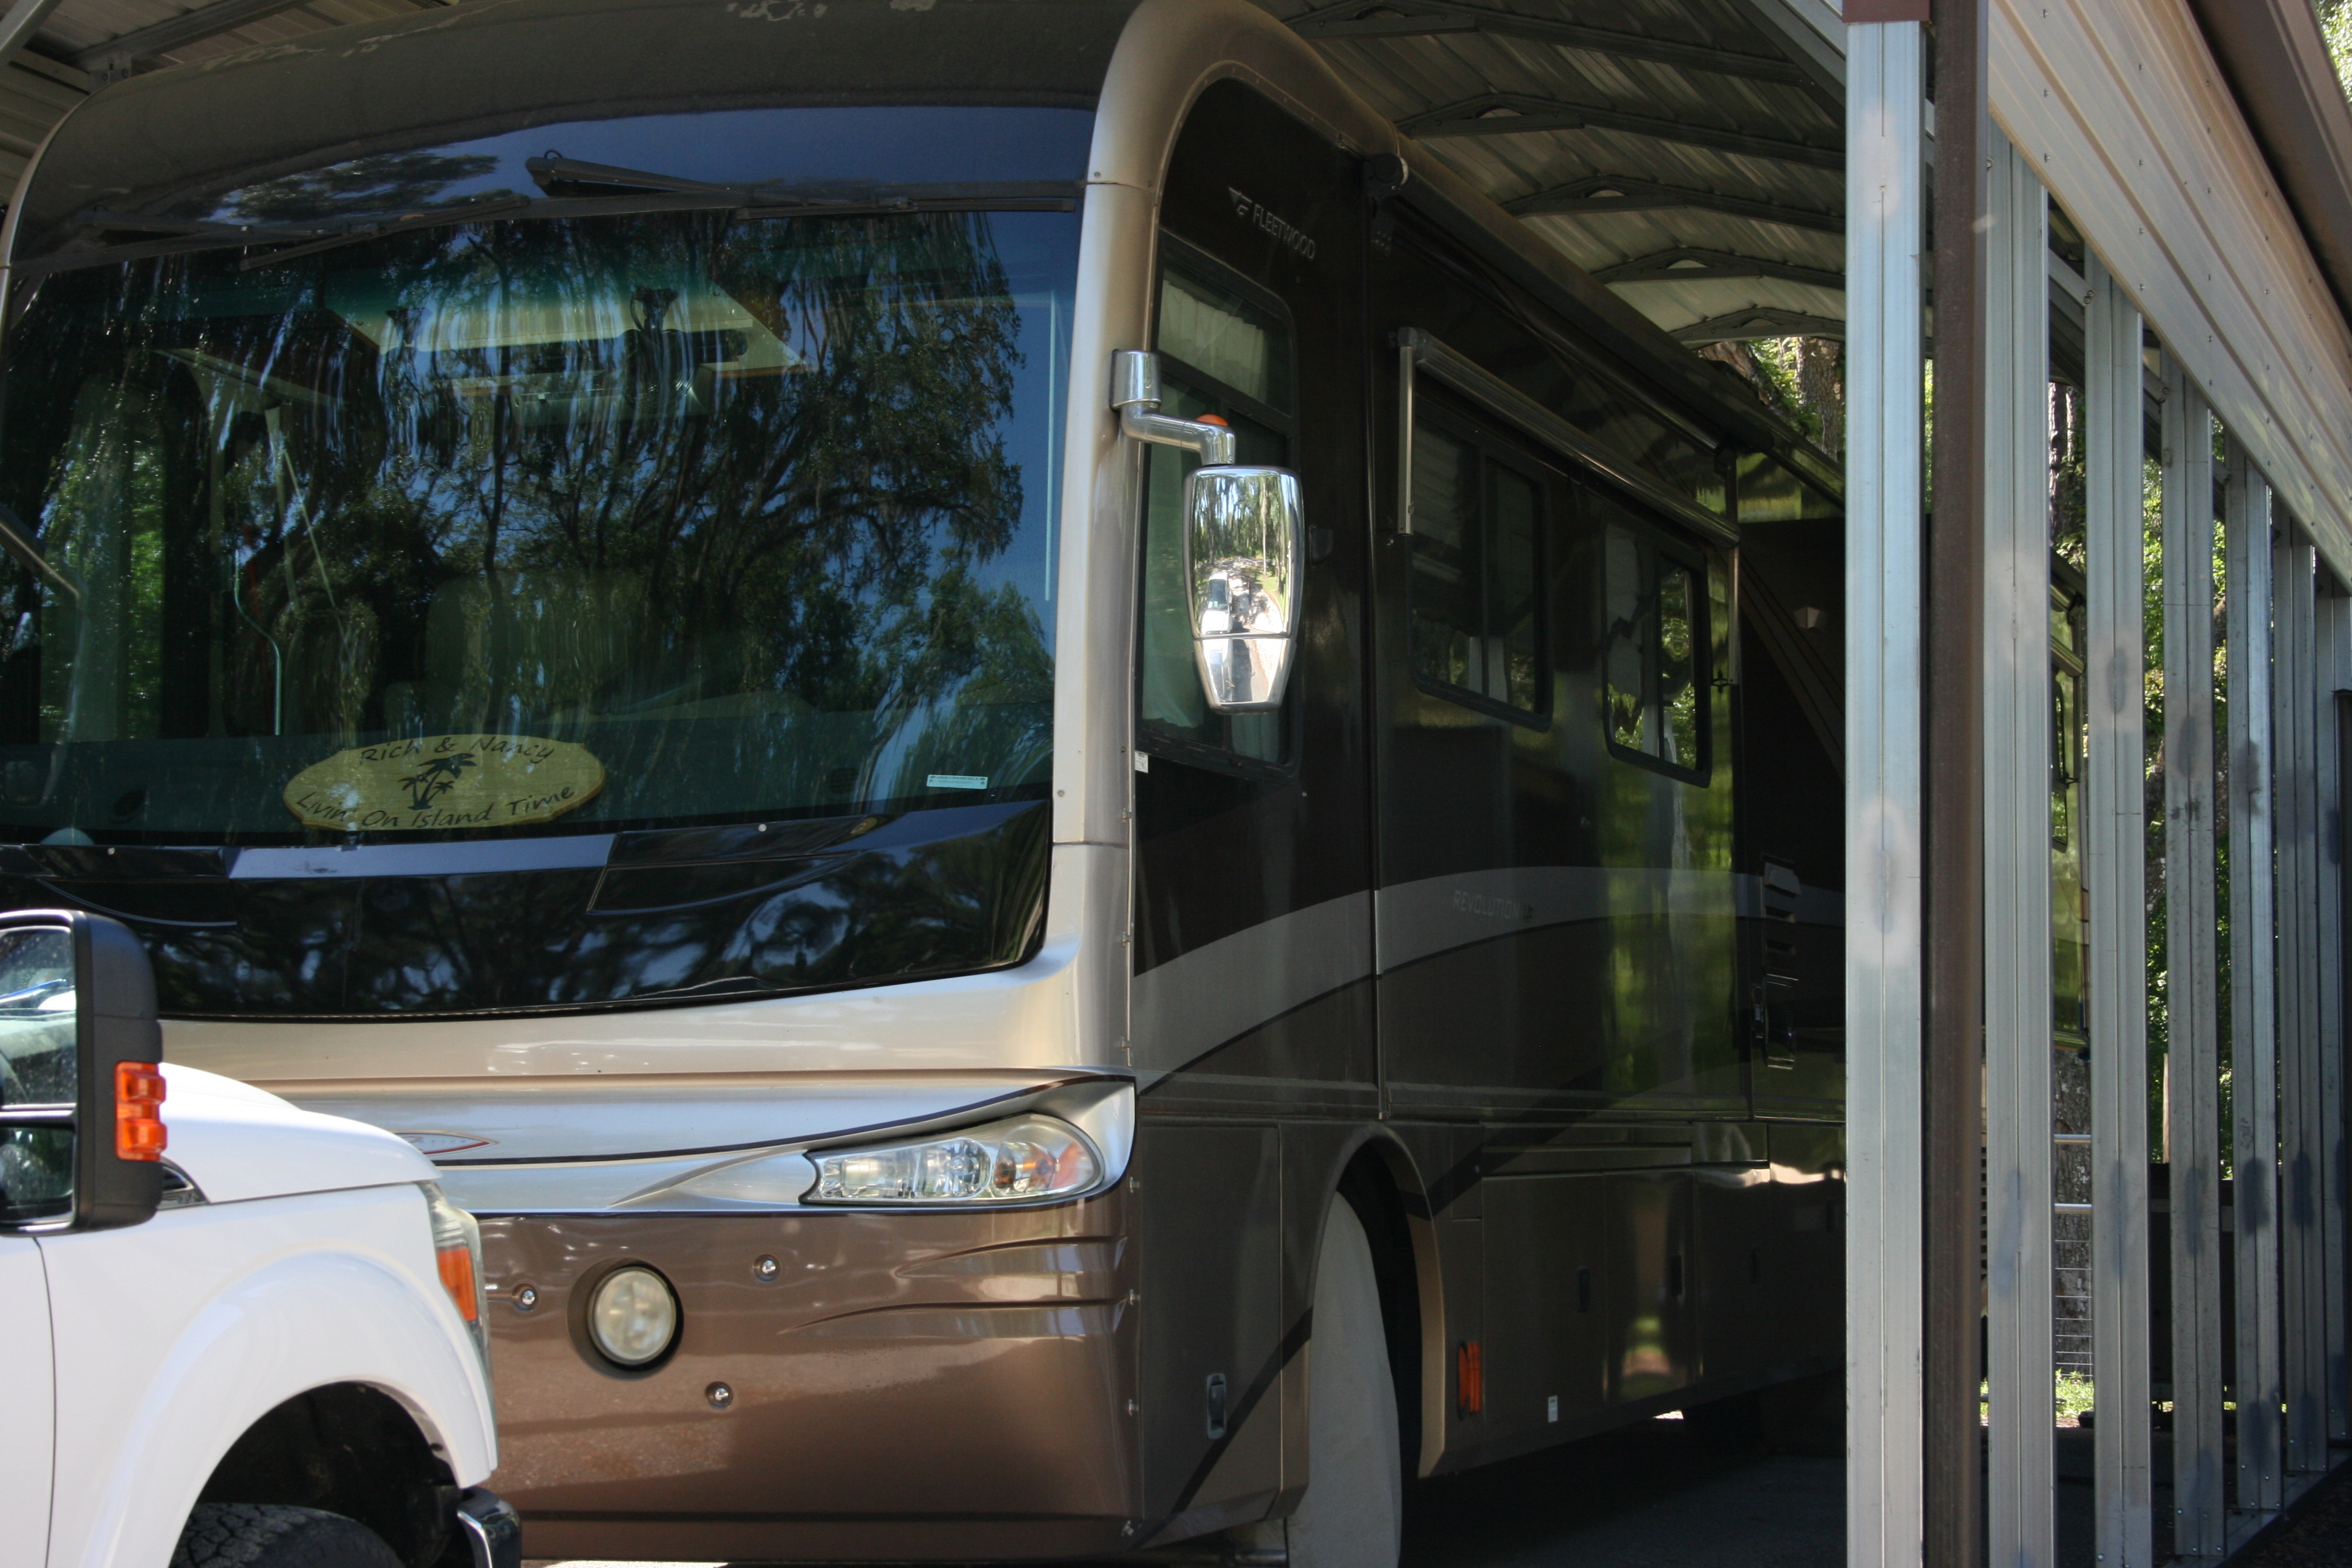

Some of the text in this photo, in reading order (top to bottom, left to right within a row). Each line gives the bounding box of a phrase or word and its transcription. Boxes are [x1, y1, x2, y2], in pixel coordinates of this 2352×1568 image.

[1252, 203, 1316, 261] FLEETWOOD
[362, 736, 555, 764] Rich & Nancy
[362, 809, 399, 827] On
[411, 802, 494, 828] Island
[505, 786, 575, 815] Time
[1452, 890, 1521, 920] REVOLUTION
